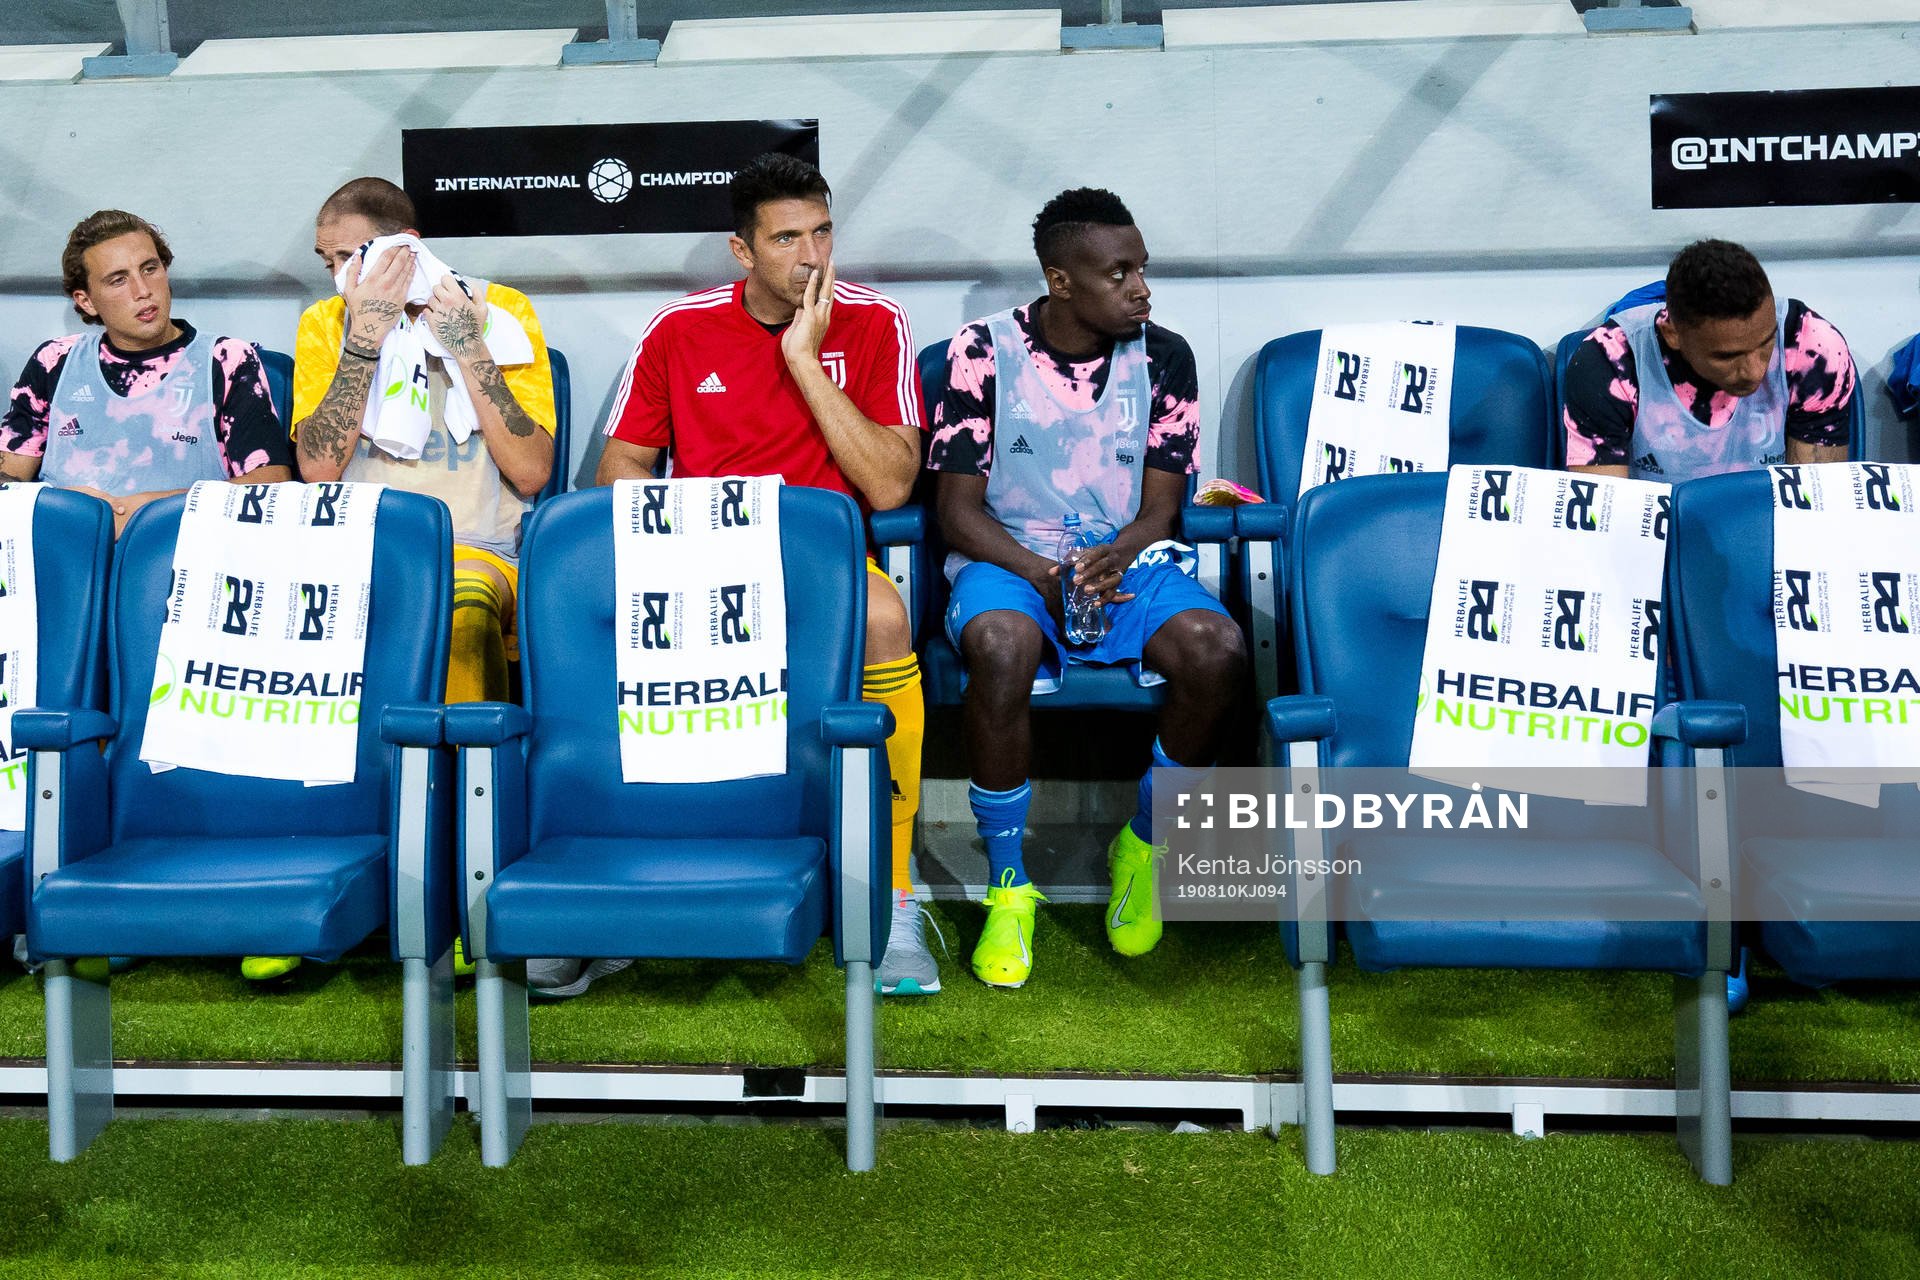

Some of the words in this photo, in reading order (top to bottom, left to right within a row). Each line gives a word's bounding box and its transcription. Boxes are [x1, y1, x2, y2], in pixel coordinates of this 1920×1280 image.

[1671, 132, 1920, 170] @INTCHAMP
[435, 175, 580, 191] INTERNATIONAL
[640, 171, 737, 186] CHAMPION
[1358, 357, 1371, 403] HERBALIFE
[1425, 367, 1438, 415] HERBALIFE
[58, 429, 84, 437] adidas
[171, 431, 198, 445] Jeep
[1010, 446, 1034, 456] adidas
[1115, 453, 1134, 465] eep
[1348, 449, 1357, 478] HERBA
[337, 484, 354, 526] ERBALIFE
[632, 485, 641, 534] HERBALIFE
[711, 482, 720, 530] HERBALIFE
[1468, 469, 1482, 519] HERBALIFE
[1553, 478, 1568, 528] HERBALIFE
[1641, 493, 1655, 537] HERBALIFE
[171, 568, 188, 625] HERBALIFE
[249, 581, 265, 637] HERBALIFE
[325, 584, 340, 641] HERBALIFE
[631, 592, 640, 649] HERBALIFE
[710, 587, 718, 645] HERBALIFE
[1455, 579, 1468, 637] HERBALIFE
[1542, 588, 1554, 648] HERBALIFE
[1860, 571, 1872, 632] HERBALIFE
[1630, 598, 1642, 658] HERBALIFE
[184, 660, 363, 697] HERBALIF
[1437, 669, 1655, 718] HERBALIF
[1777, 663, 1920, 693] HERBA
[180, 687, 360, 725] NUTRITIO
[619, 697, 787, 735] NUTRITI
[1435, 698, 1648, 747] NUTRITIO
[1779, 693, 1920, 724] NUTRI
